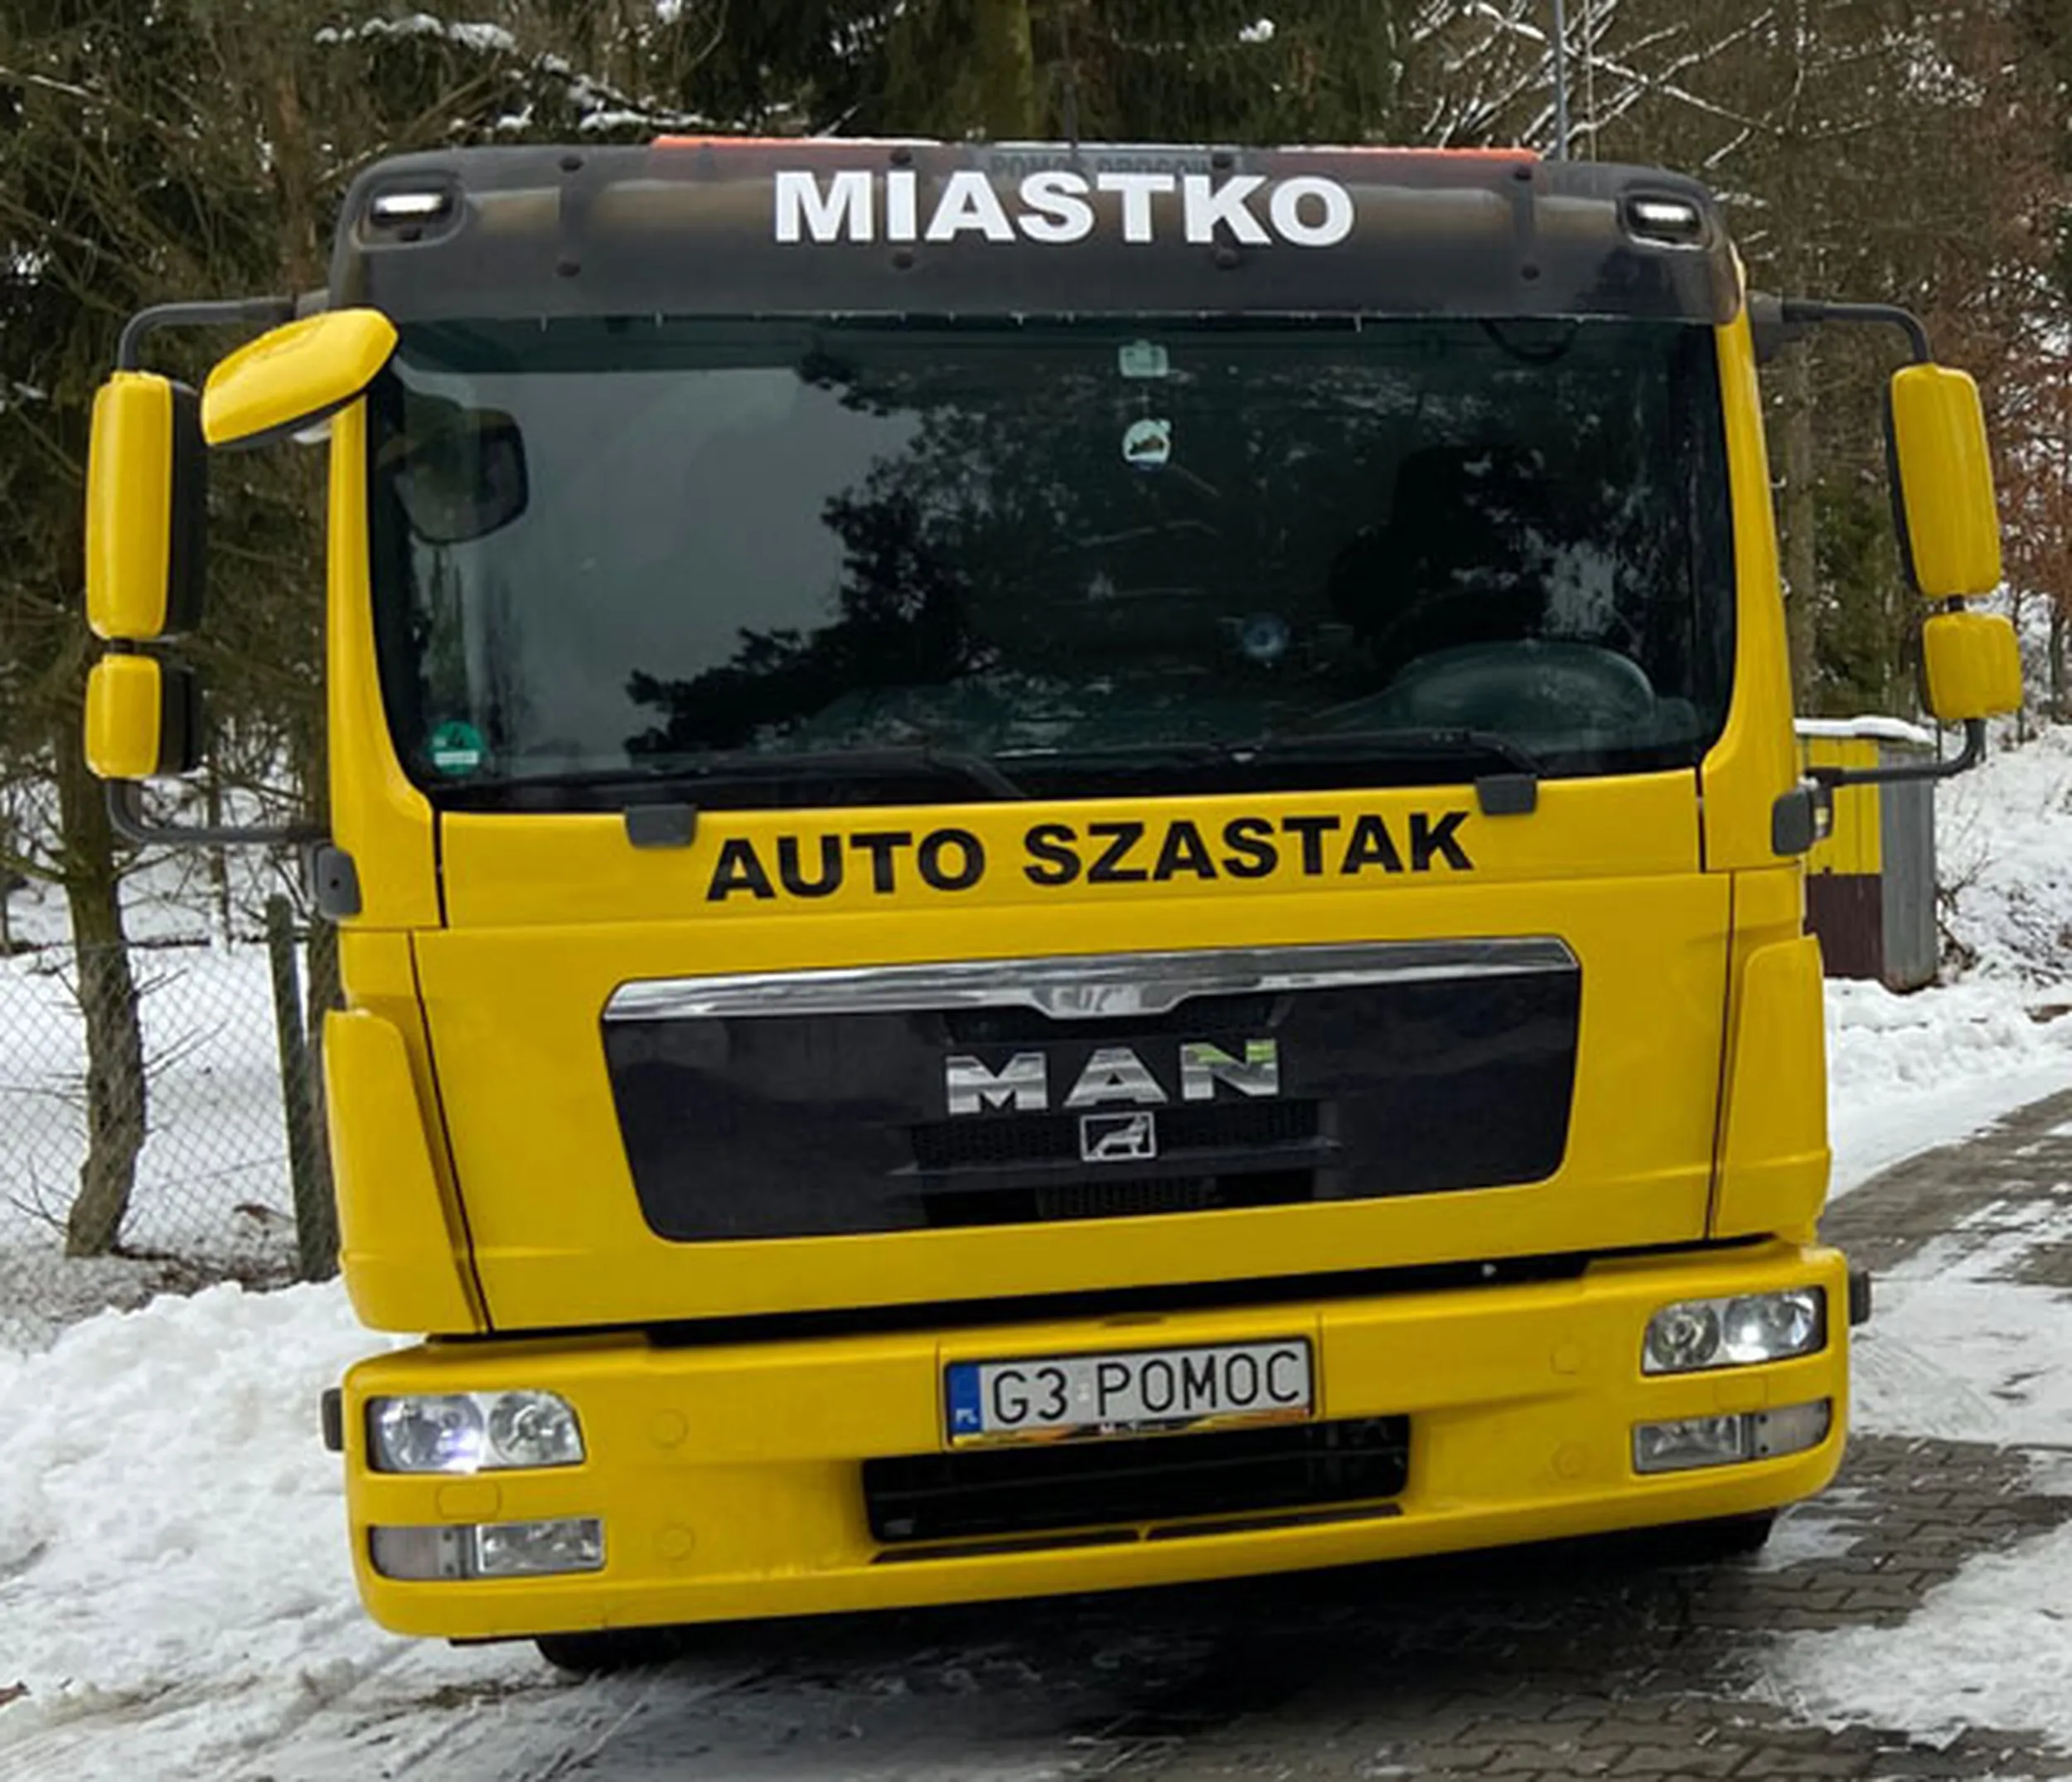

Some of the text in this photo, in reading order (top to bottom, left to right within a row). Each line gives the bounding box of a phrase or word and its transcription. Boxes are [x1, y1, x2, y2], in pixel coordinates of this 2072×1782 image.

[775, 170, 1354, 246] MIASTKO
[705, 811, 1475, 902] AUTO SZASTAK
[945, 1039, 1280, 1116] MAN
[993, 1349, 1300, 1426] G3 POMOC
